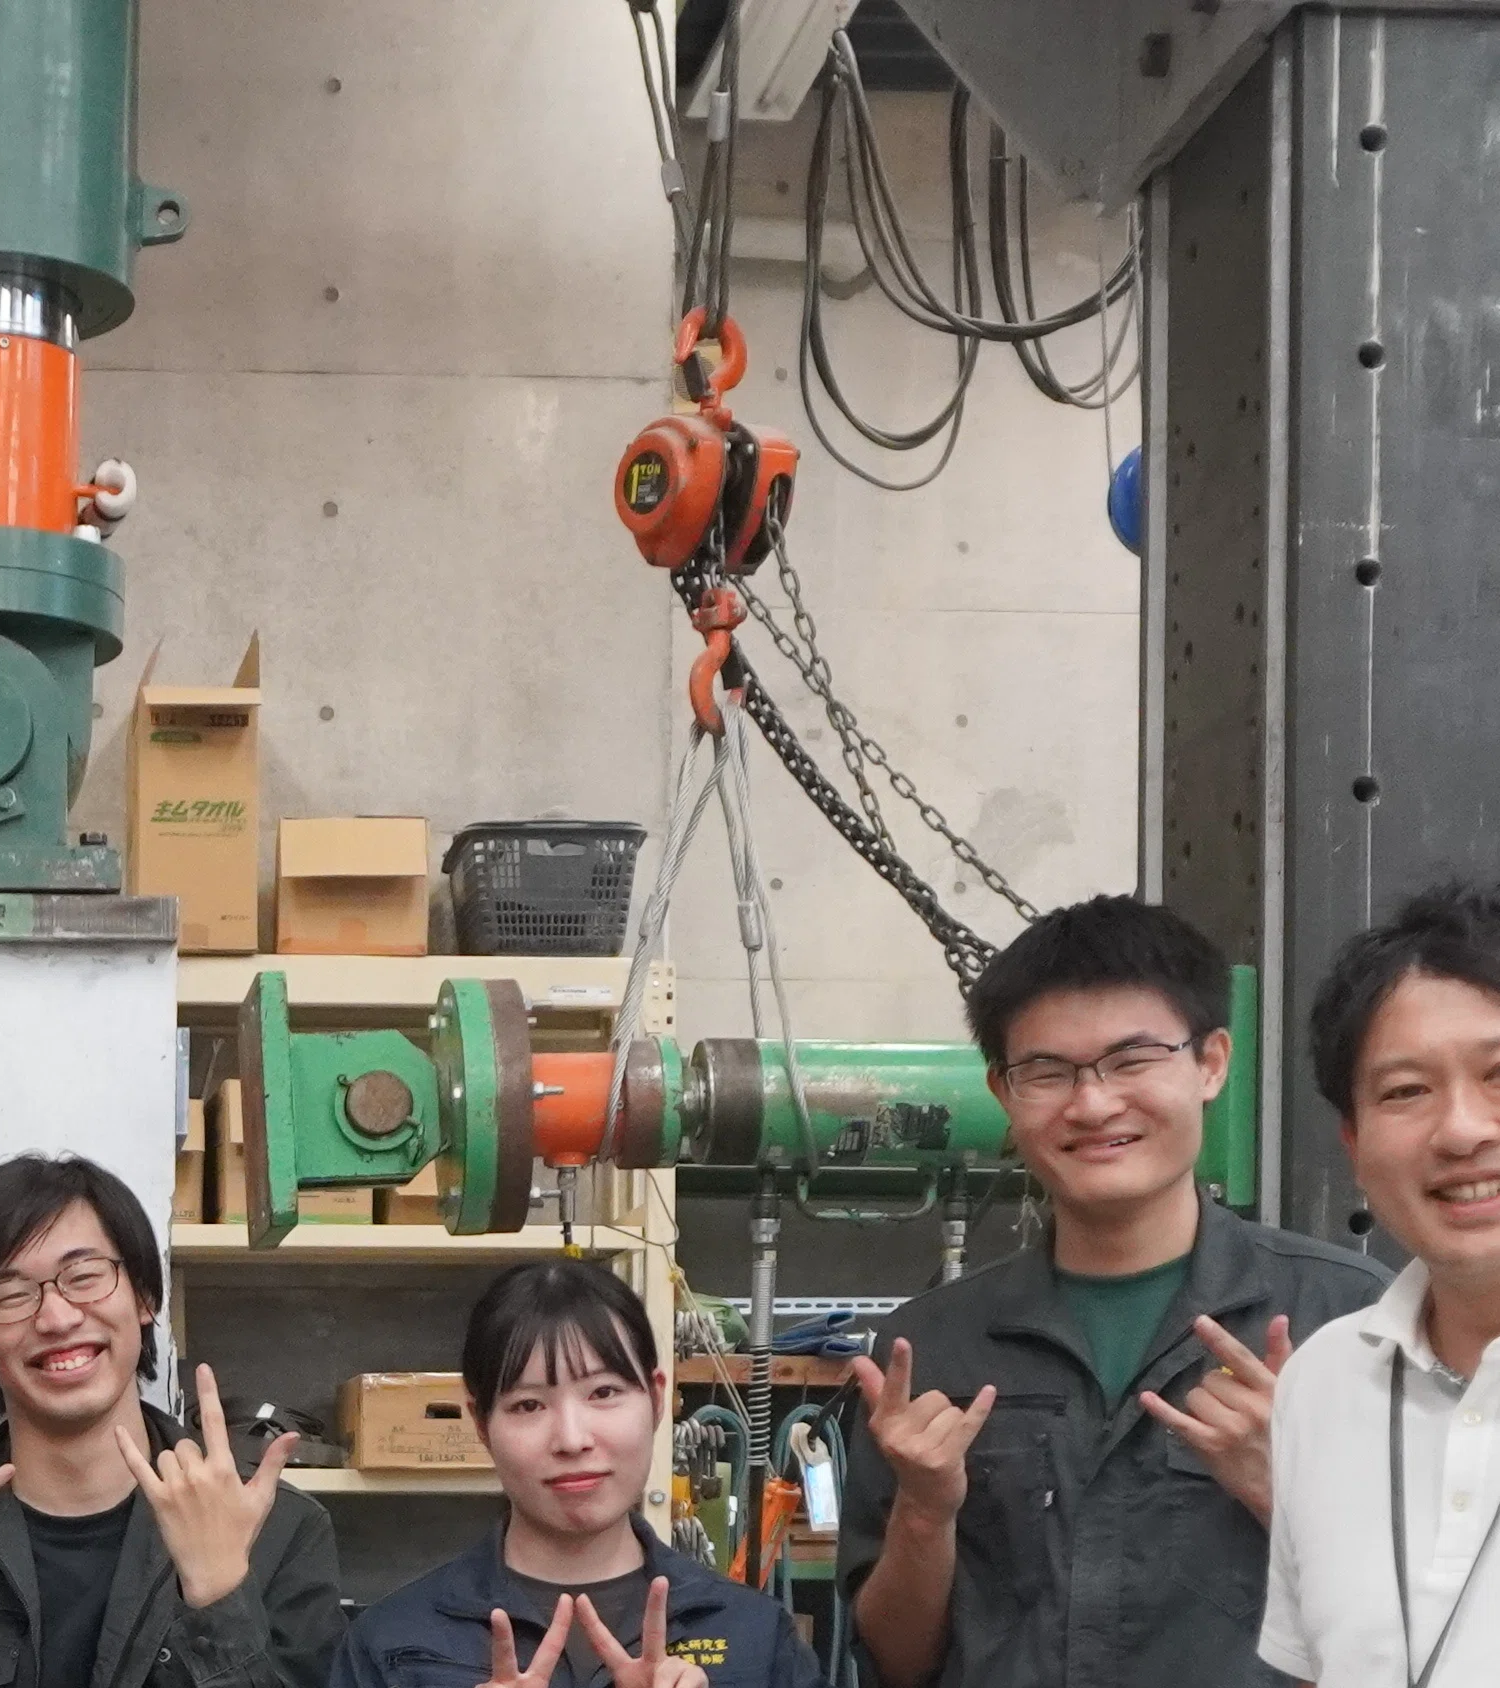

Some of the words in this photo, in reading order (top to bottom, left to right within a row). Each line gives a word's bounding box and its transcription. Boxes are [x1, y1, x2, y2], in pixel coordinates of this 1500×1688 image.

[640, 464, 661, 475] TON
[155, 800, 246, 817] キムタオル
